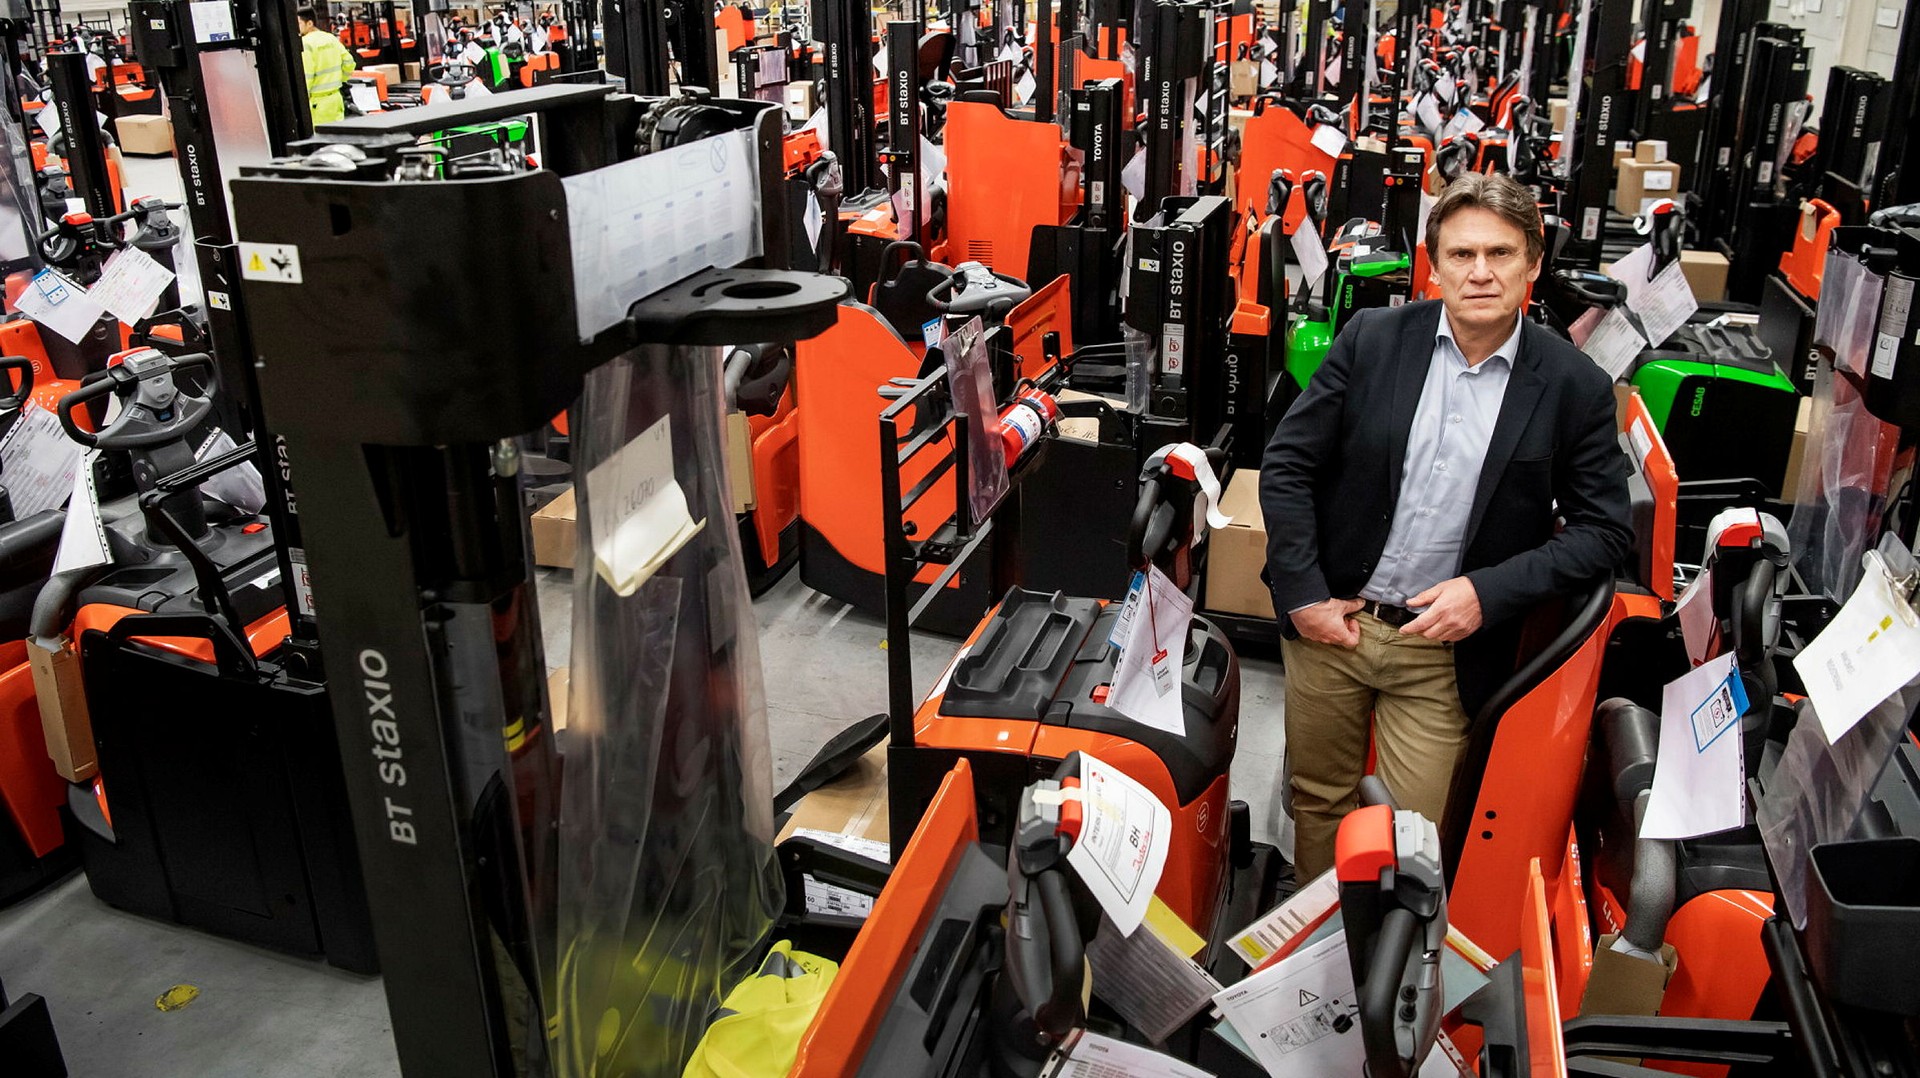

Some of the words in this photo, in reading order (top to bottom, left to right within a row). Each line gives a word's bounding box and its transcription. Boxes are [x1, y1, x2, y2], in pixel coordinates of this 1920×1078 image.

[900, 112, 909, 125] BT
[1161, 117, 1168, 129] BT
[69, 136, 76, 149] BT
[1094, 123, 1103, 161] TOYOTA
[196, 191, 205, 206] BT
[1170, 300, 1182, 319] BT
[1804, 364, 1817, 380] BT
[1690, 386, 1706, 416] CESAB
[385, 797, 417, 845] BT
